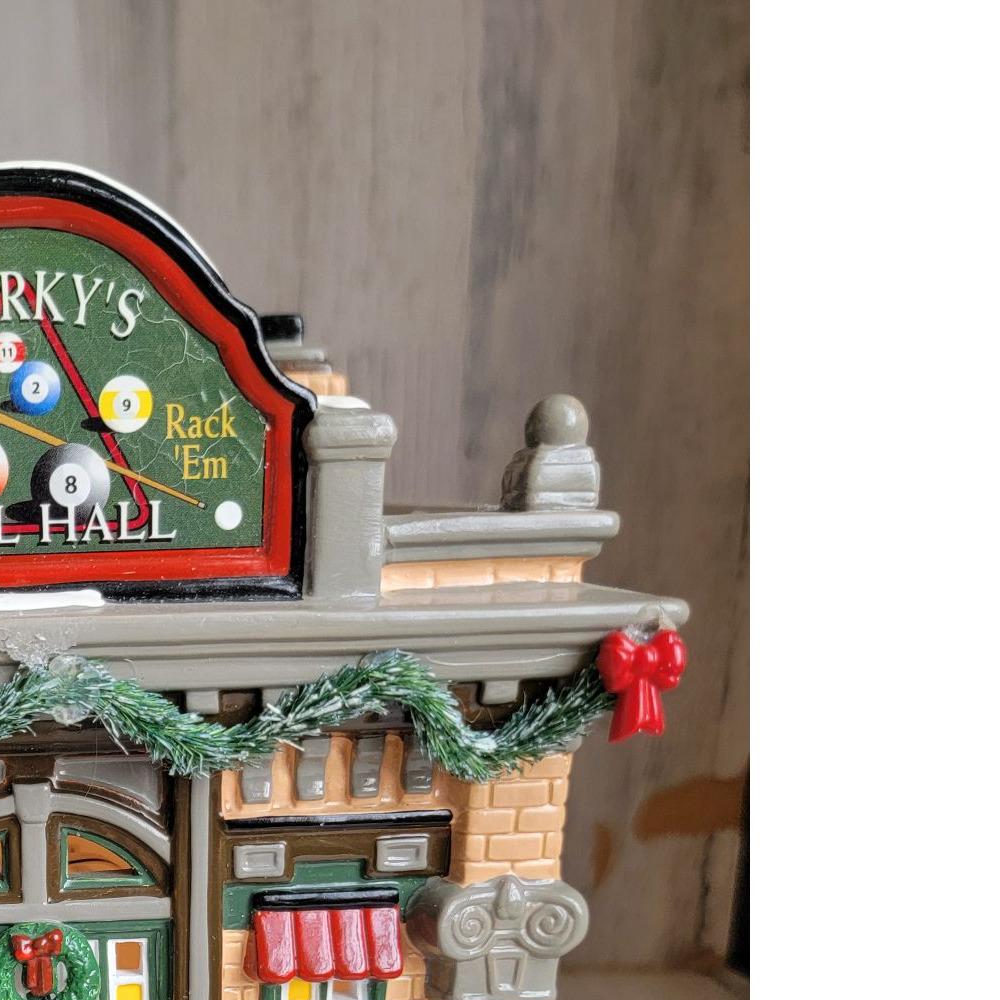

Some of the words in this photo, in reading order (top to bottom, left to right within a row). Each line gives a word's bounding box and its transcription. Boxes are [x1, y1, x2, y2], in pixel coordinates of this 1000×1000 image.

[1, 348, 14, 358] 11
[31, 381, 41, 394] 2
[122, 399, 132, 412] 9
[166, 402, 237, 440] Rack
[174, 444, 229, 480] 'Em
[64, 475, 78, 494] 8
[40, 500, 177, 544] HALL
